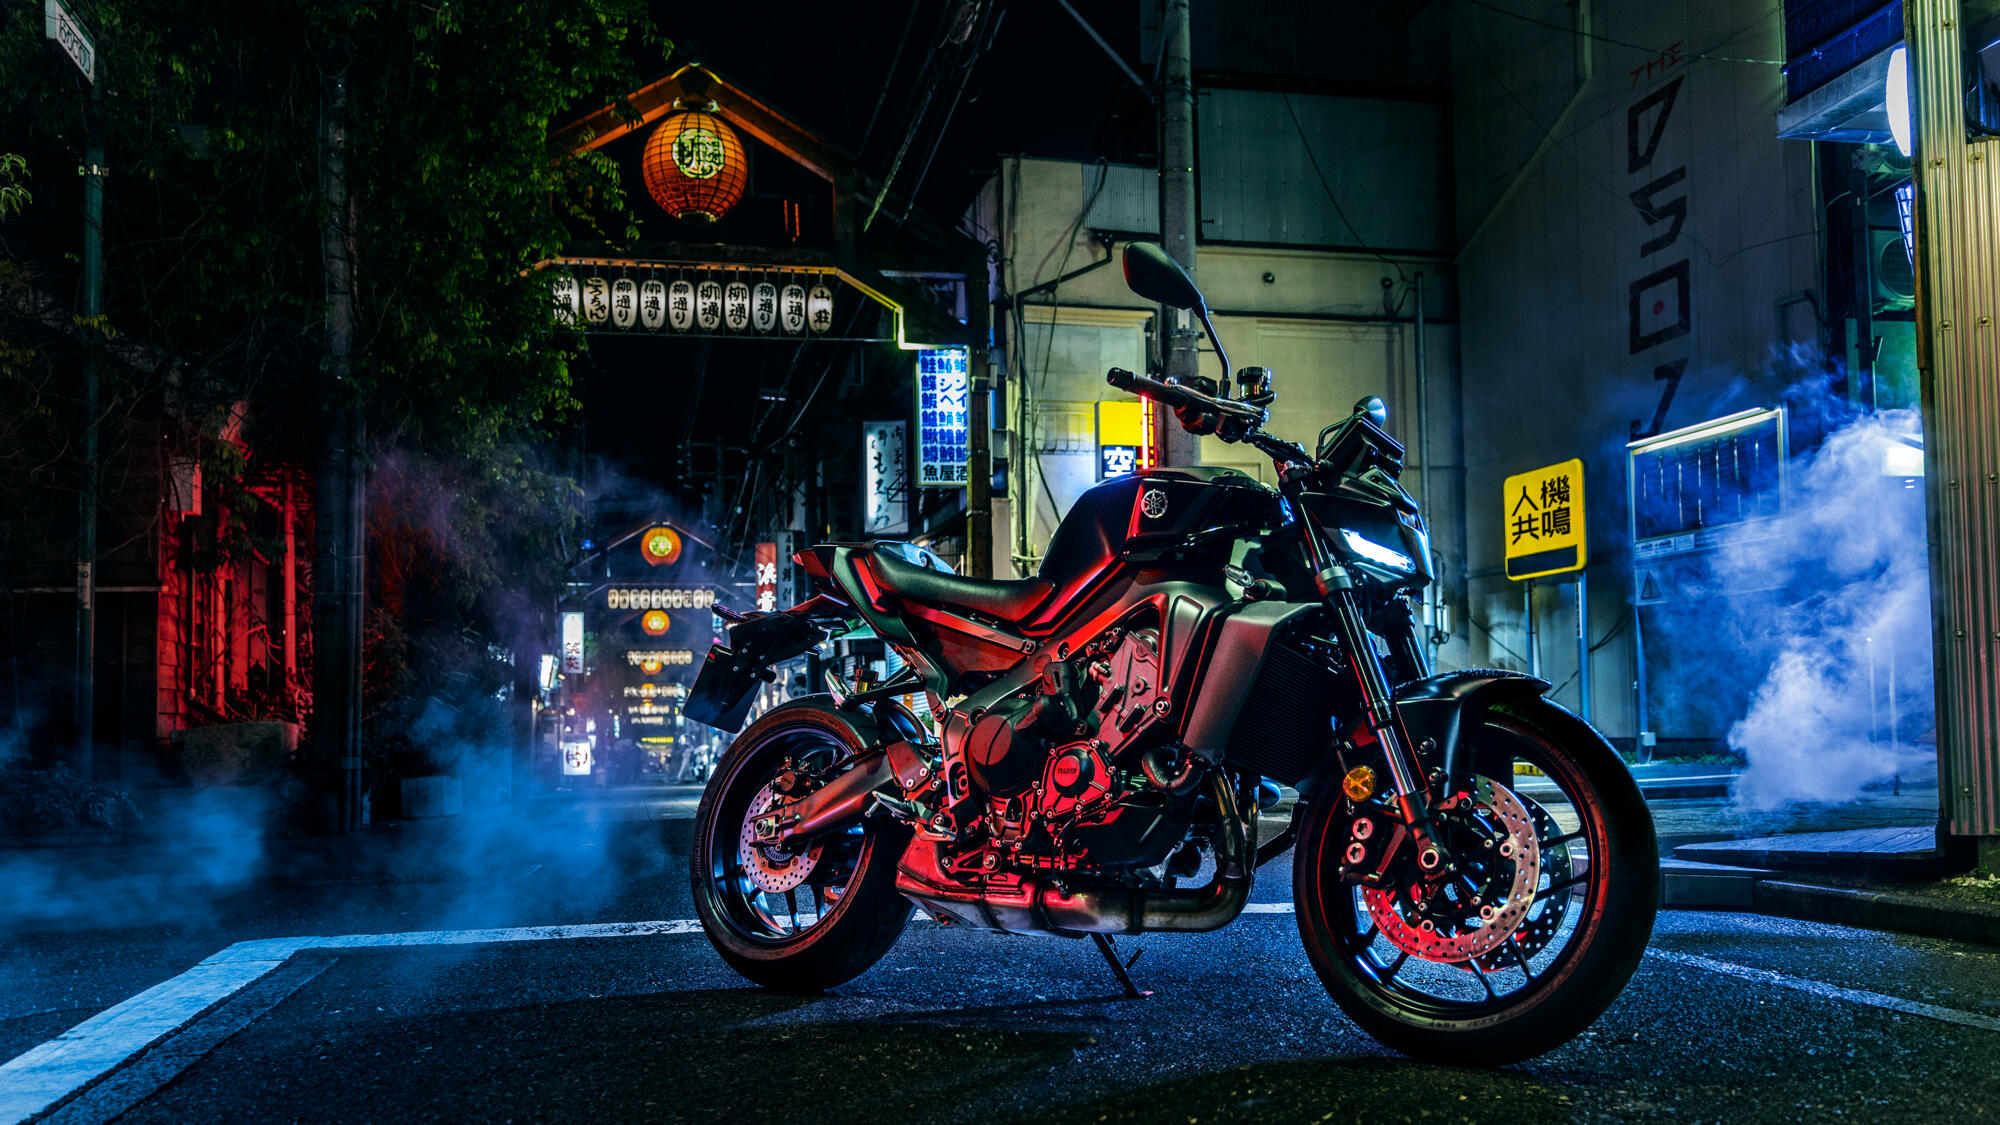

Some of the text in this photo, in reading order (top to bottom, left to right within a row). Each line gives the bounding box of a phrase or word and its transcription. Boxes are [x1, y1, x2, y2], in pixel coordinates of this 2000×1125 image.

[1629, 40, 1683, 89] THE
[616, 281, 632, 323] 柳通り
[644, 282, 661, 321] 柳通り
[672, 283, 689, 325] 柳通り
[700, 284, 720, 325] 柳通り
[728, 286, 747, 325] 柳通り
[758, 285, 774, 325] 柳通り
[788, 287, 803, 327] 柳通り
[1103, 446, 1134, 478] 空
[1512, 475, 1570, 517] 人機
[1512, 506, 1571, 545] 共鳴
